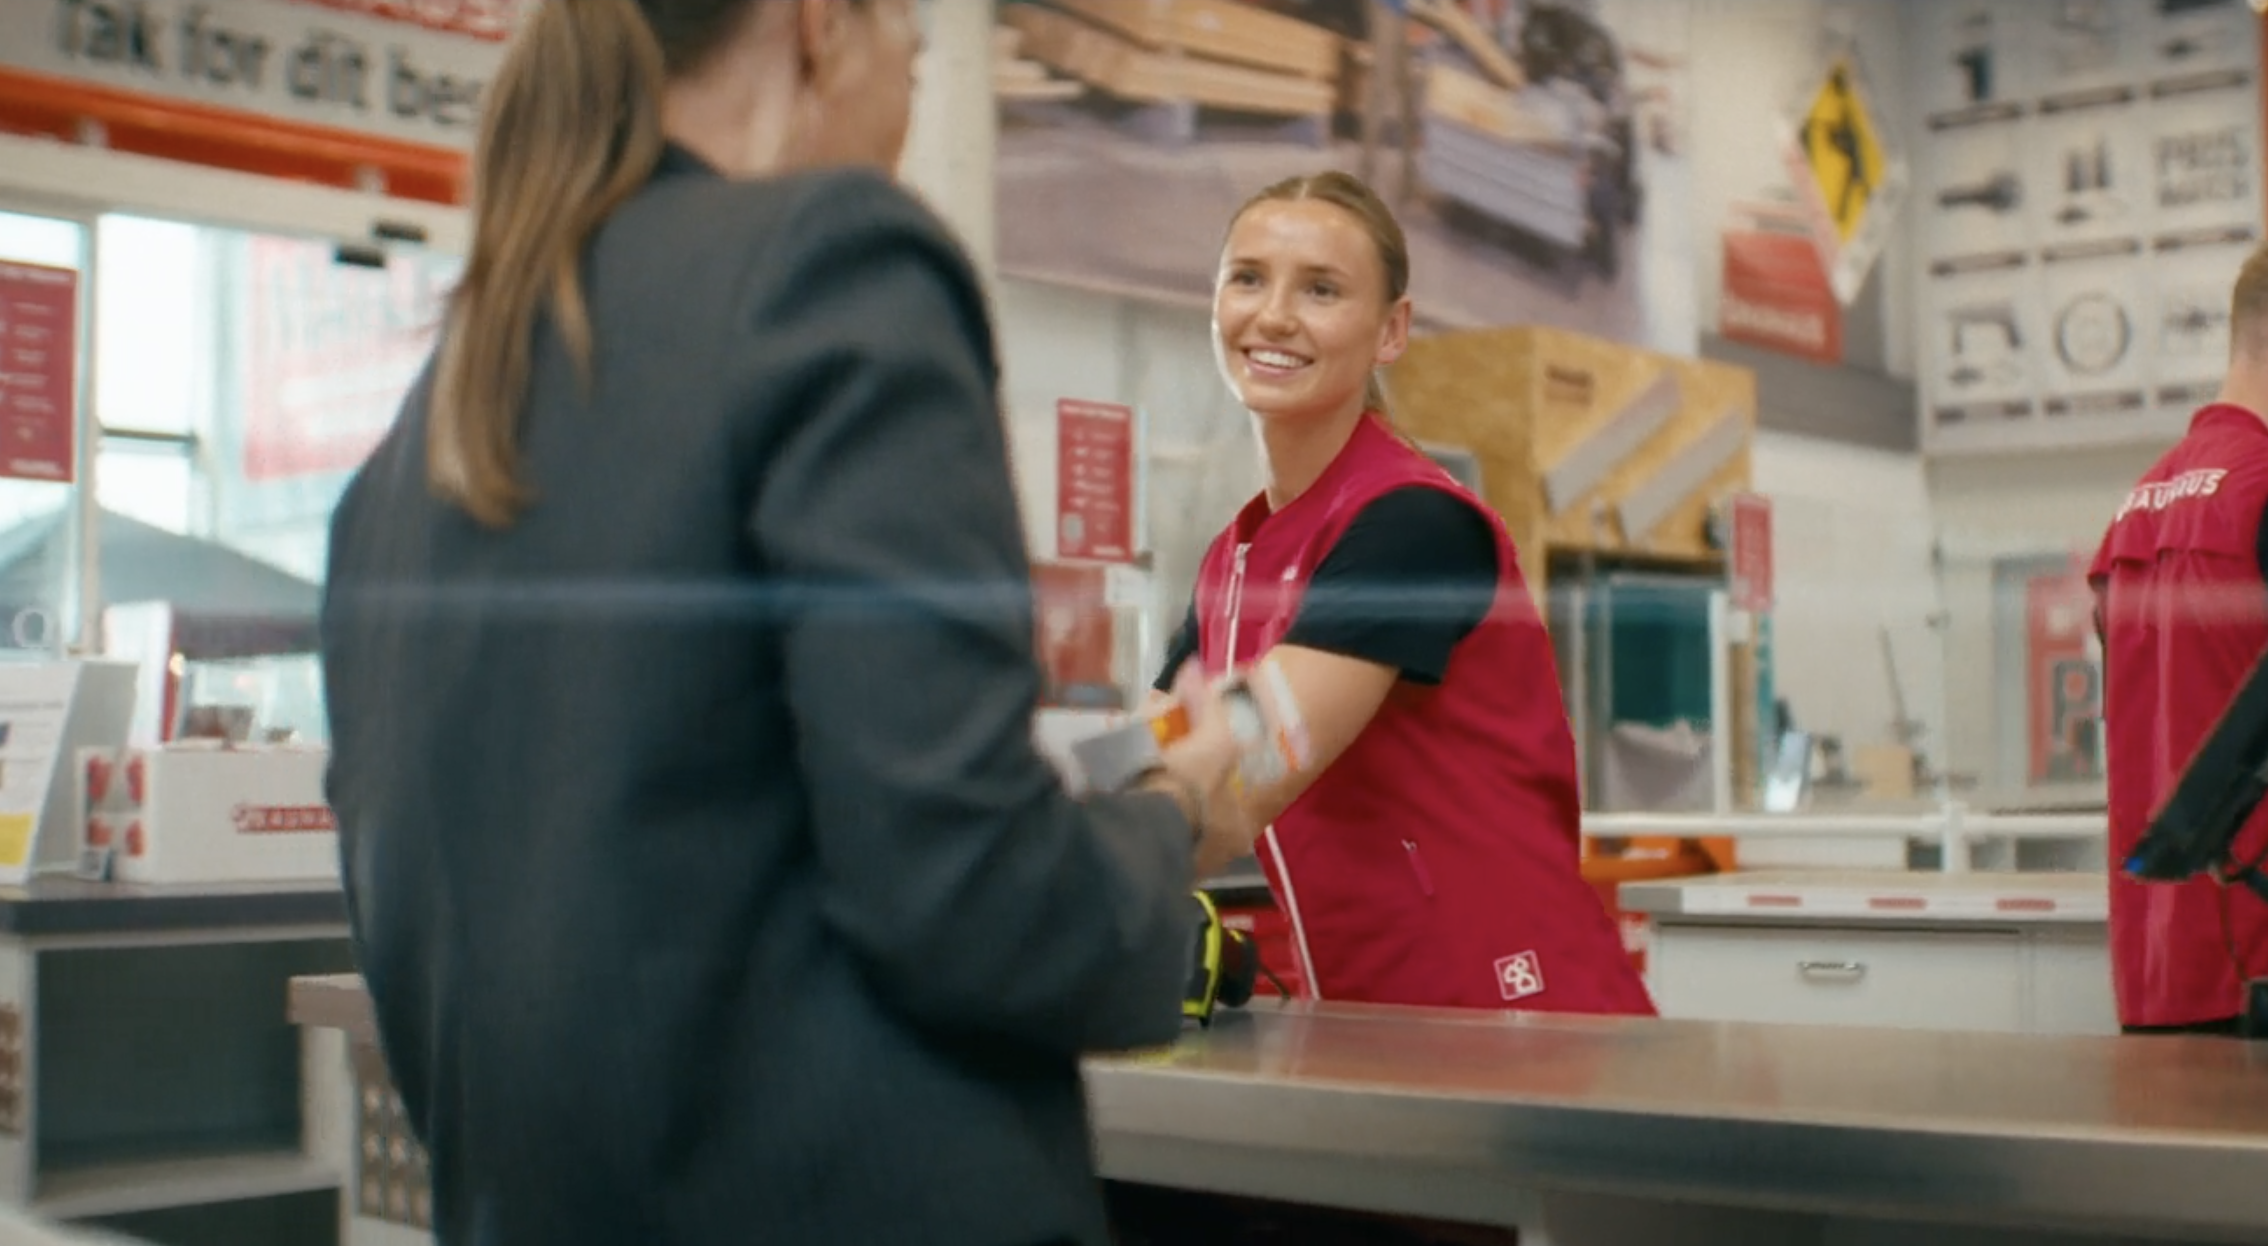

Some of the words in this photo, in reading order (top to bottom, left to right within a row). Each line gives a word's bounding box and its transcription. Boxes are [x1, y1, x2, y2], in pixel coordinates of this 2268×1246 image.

[176, 2, 269, 91] for
[285, 27, 370, 112] dit
[2116, 470, 2220, 521] AUUS
